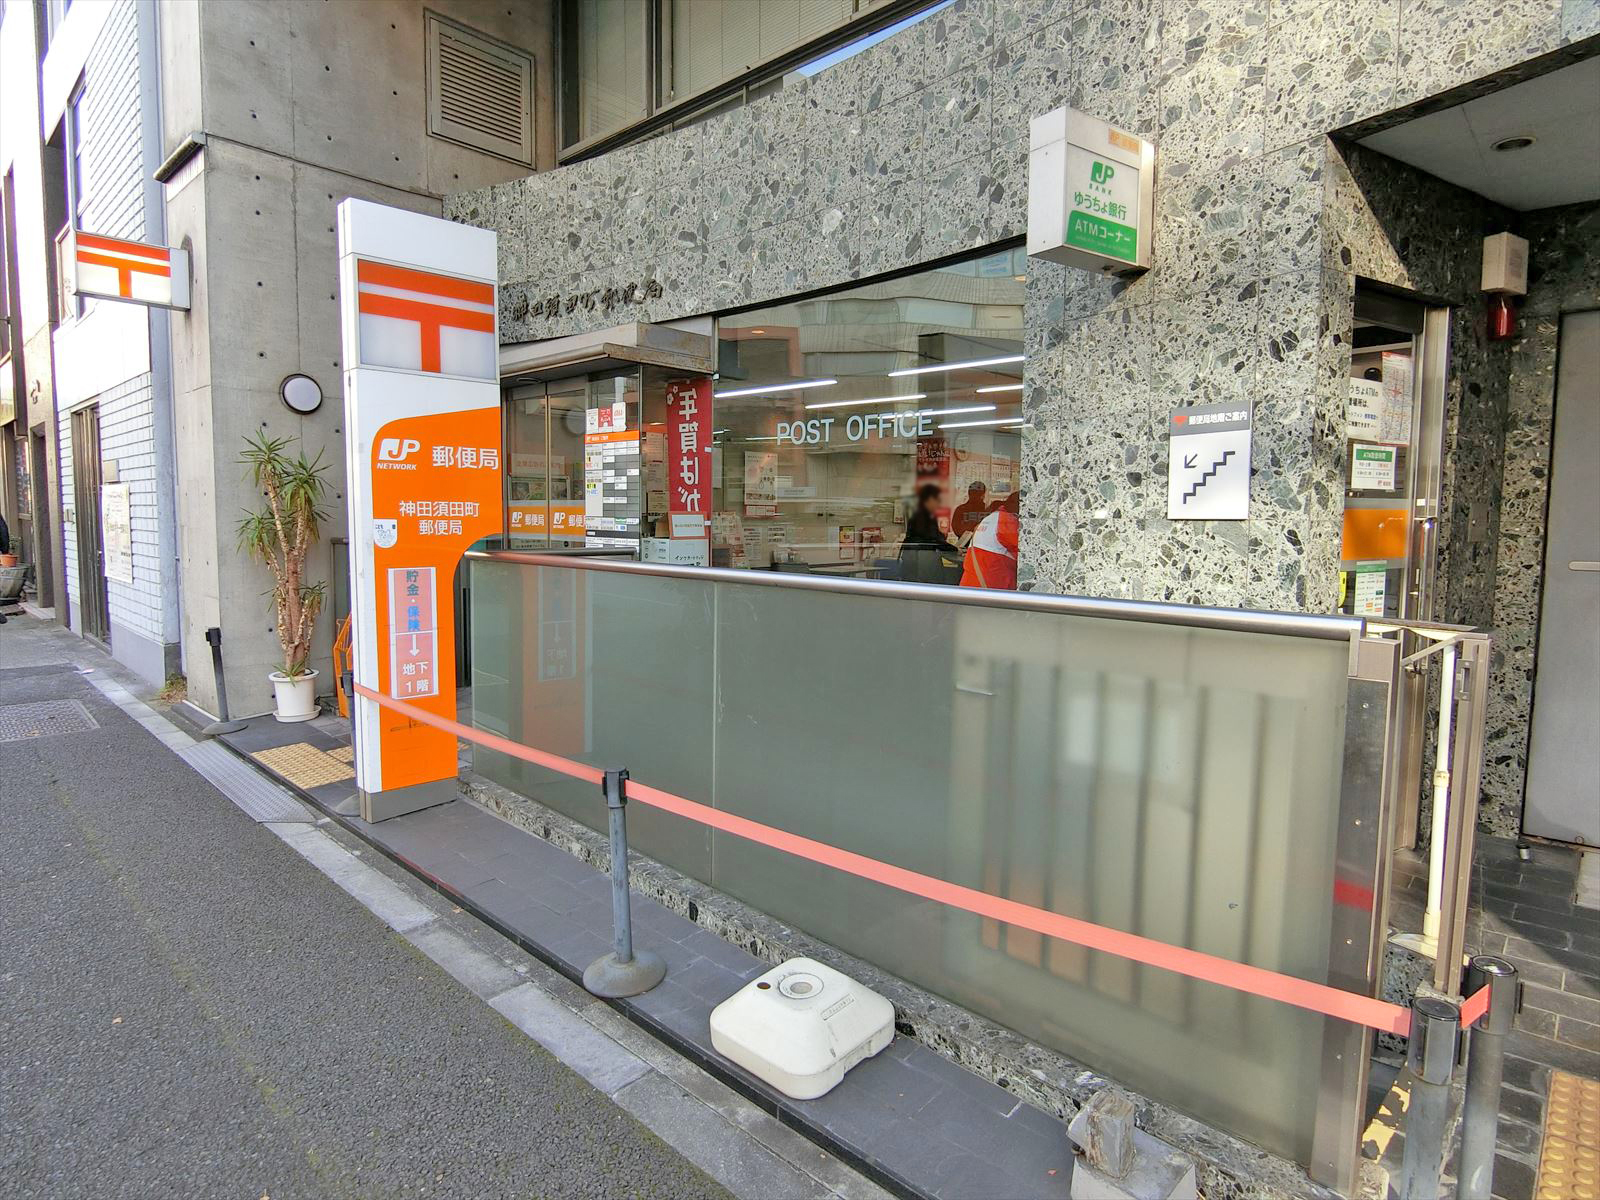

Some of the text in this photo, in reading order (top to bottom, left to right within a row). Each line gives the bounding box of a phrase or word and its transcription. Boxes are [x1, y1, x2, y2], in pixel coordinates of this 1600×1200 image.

[1090, 161, 1114, 185] JP
[1074, 191, 1127, 221] ゆうちょ銀行
[1075, 218, 1131, 242] ATMコーナー
[776, 408, 934, 446] POST OFFICE
[378, 438, 421, 461] JP
[432, 445, 499, 470] 郵便局
[376, 462, 417, 471] NETWORK
[399, 500, 480, 517] 神田須田町
[418, 519, 463, 535] 郵便局
[568, 514, 585, 527] 郵便
[402, 661, 429, 676] 地下
[406, 680, 429, 692] 1階
